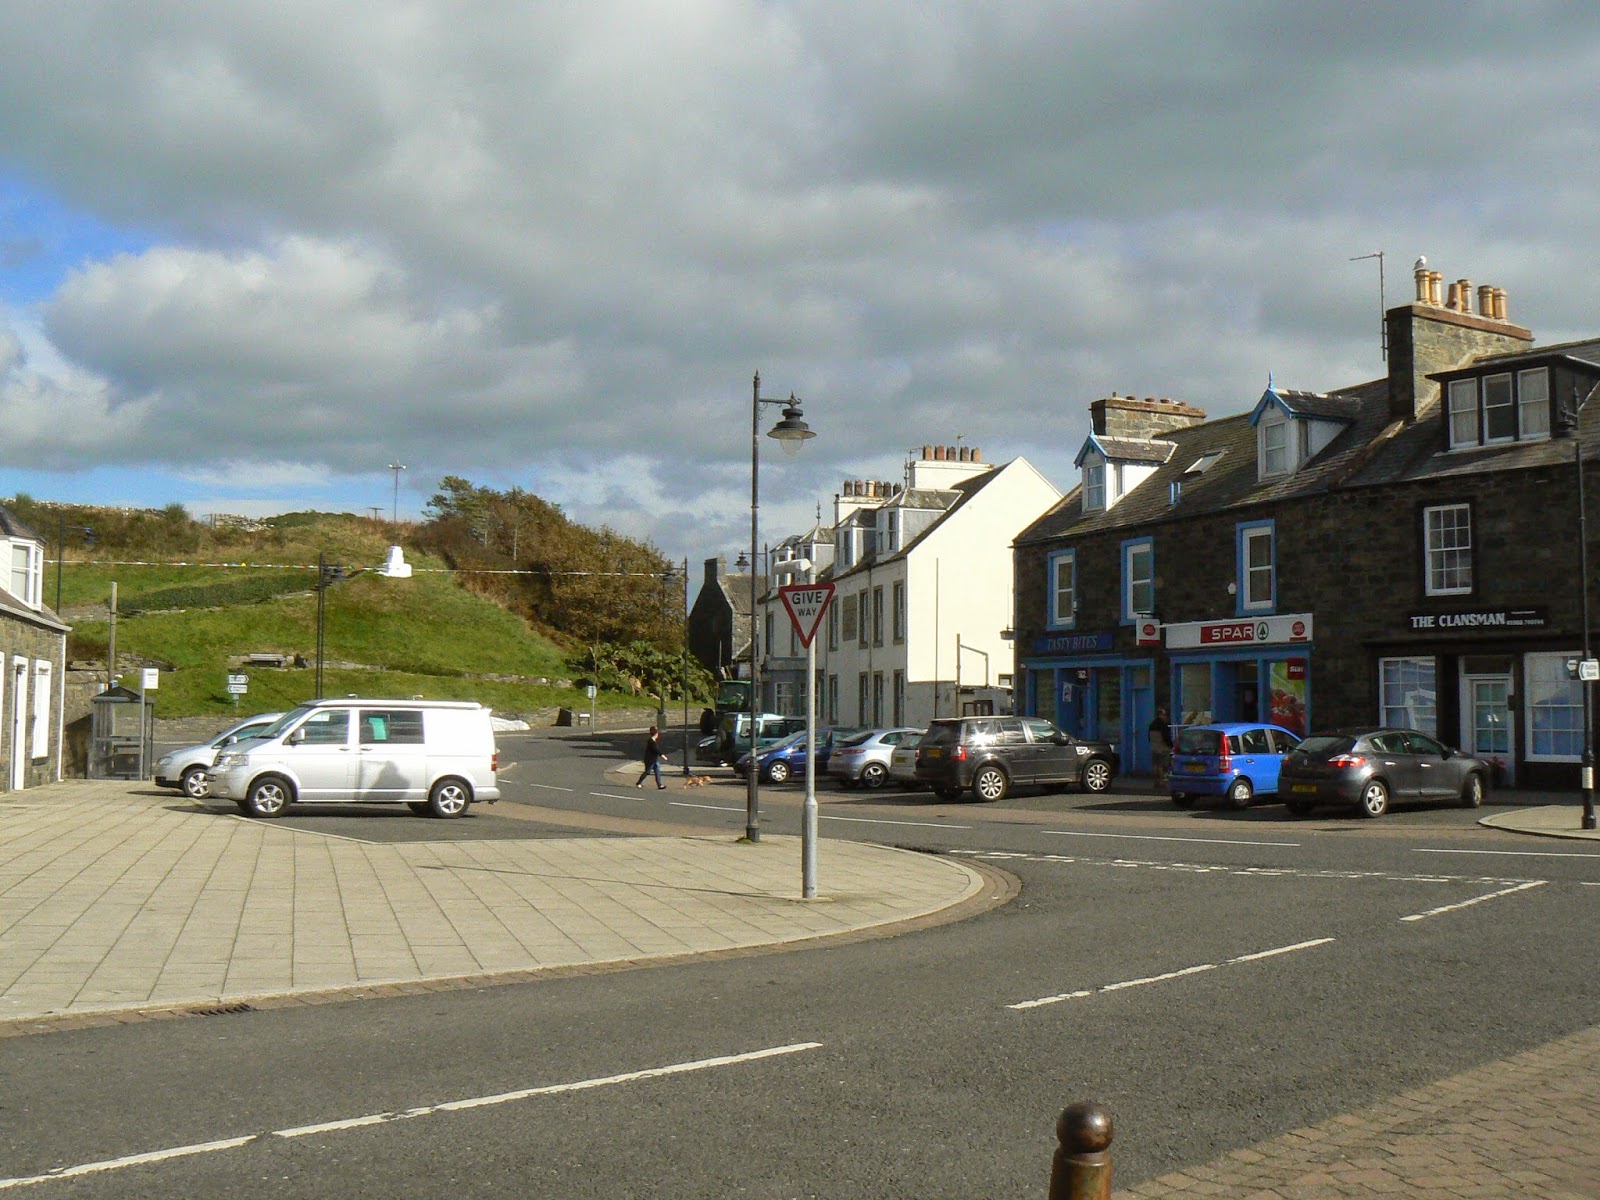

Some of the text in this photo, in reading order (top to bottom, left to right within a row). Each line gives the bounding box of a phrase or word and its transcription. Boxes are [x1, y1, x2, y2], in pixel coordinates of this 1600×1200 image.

[792, 591, 823, 605] GIVE
[798, 607, 817, 616] WAY
[1410, 616, 1435, 628] THE
[1438, 612, 1506, 627] CLANSMAN
[1211, 627, 1254, 641] SPAR
[1072, 635, 1098, 649] BITES
